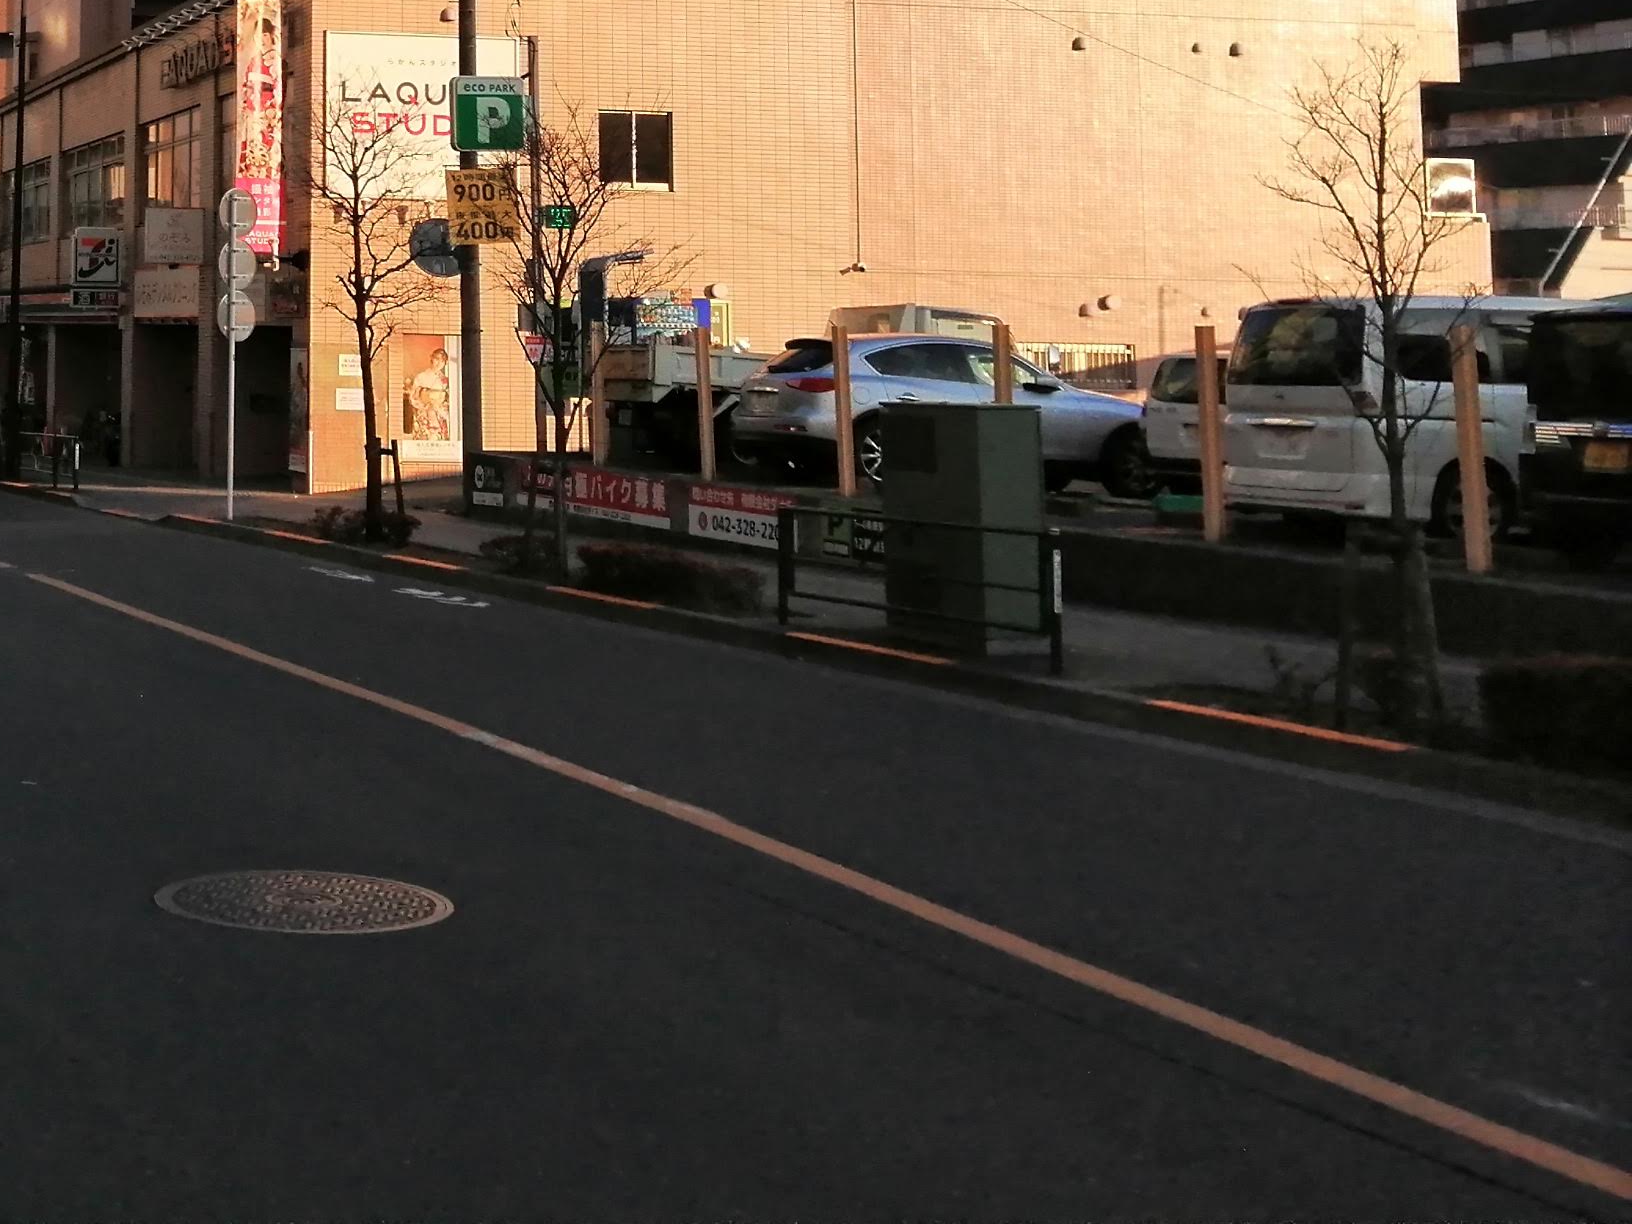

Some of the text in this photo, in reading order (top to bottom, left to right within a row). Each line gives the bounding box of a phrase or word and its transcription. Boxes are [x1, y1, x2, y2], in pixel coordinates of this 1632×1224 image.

[341, 81, 447, 105] LAQU
[464, 83, 516, 93] eco PARK
[351, 112, 451, 136] STUD
[476, 96, 512, 144] P
